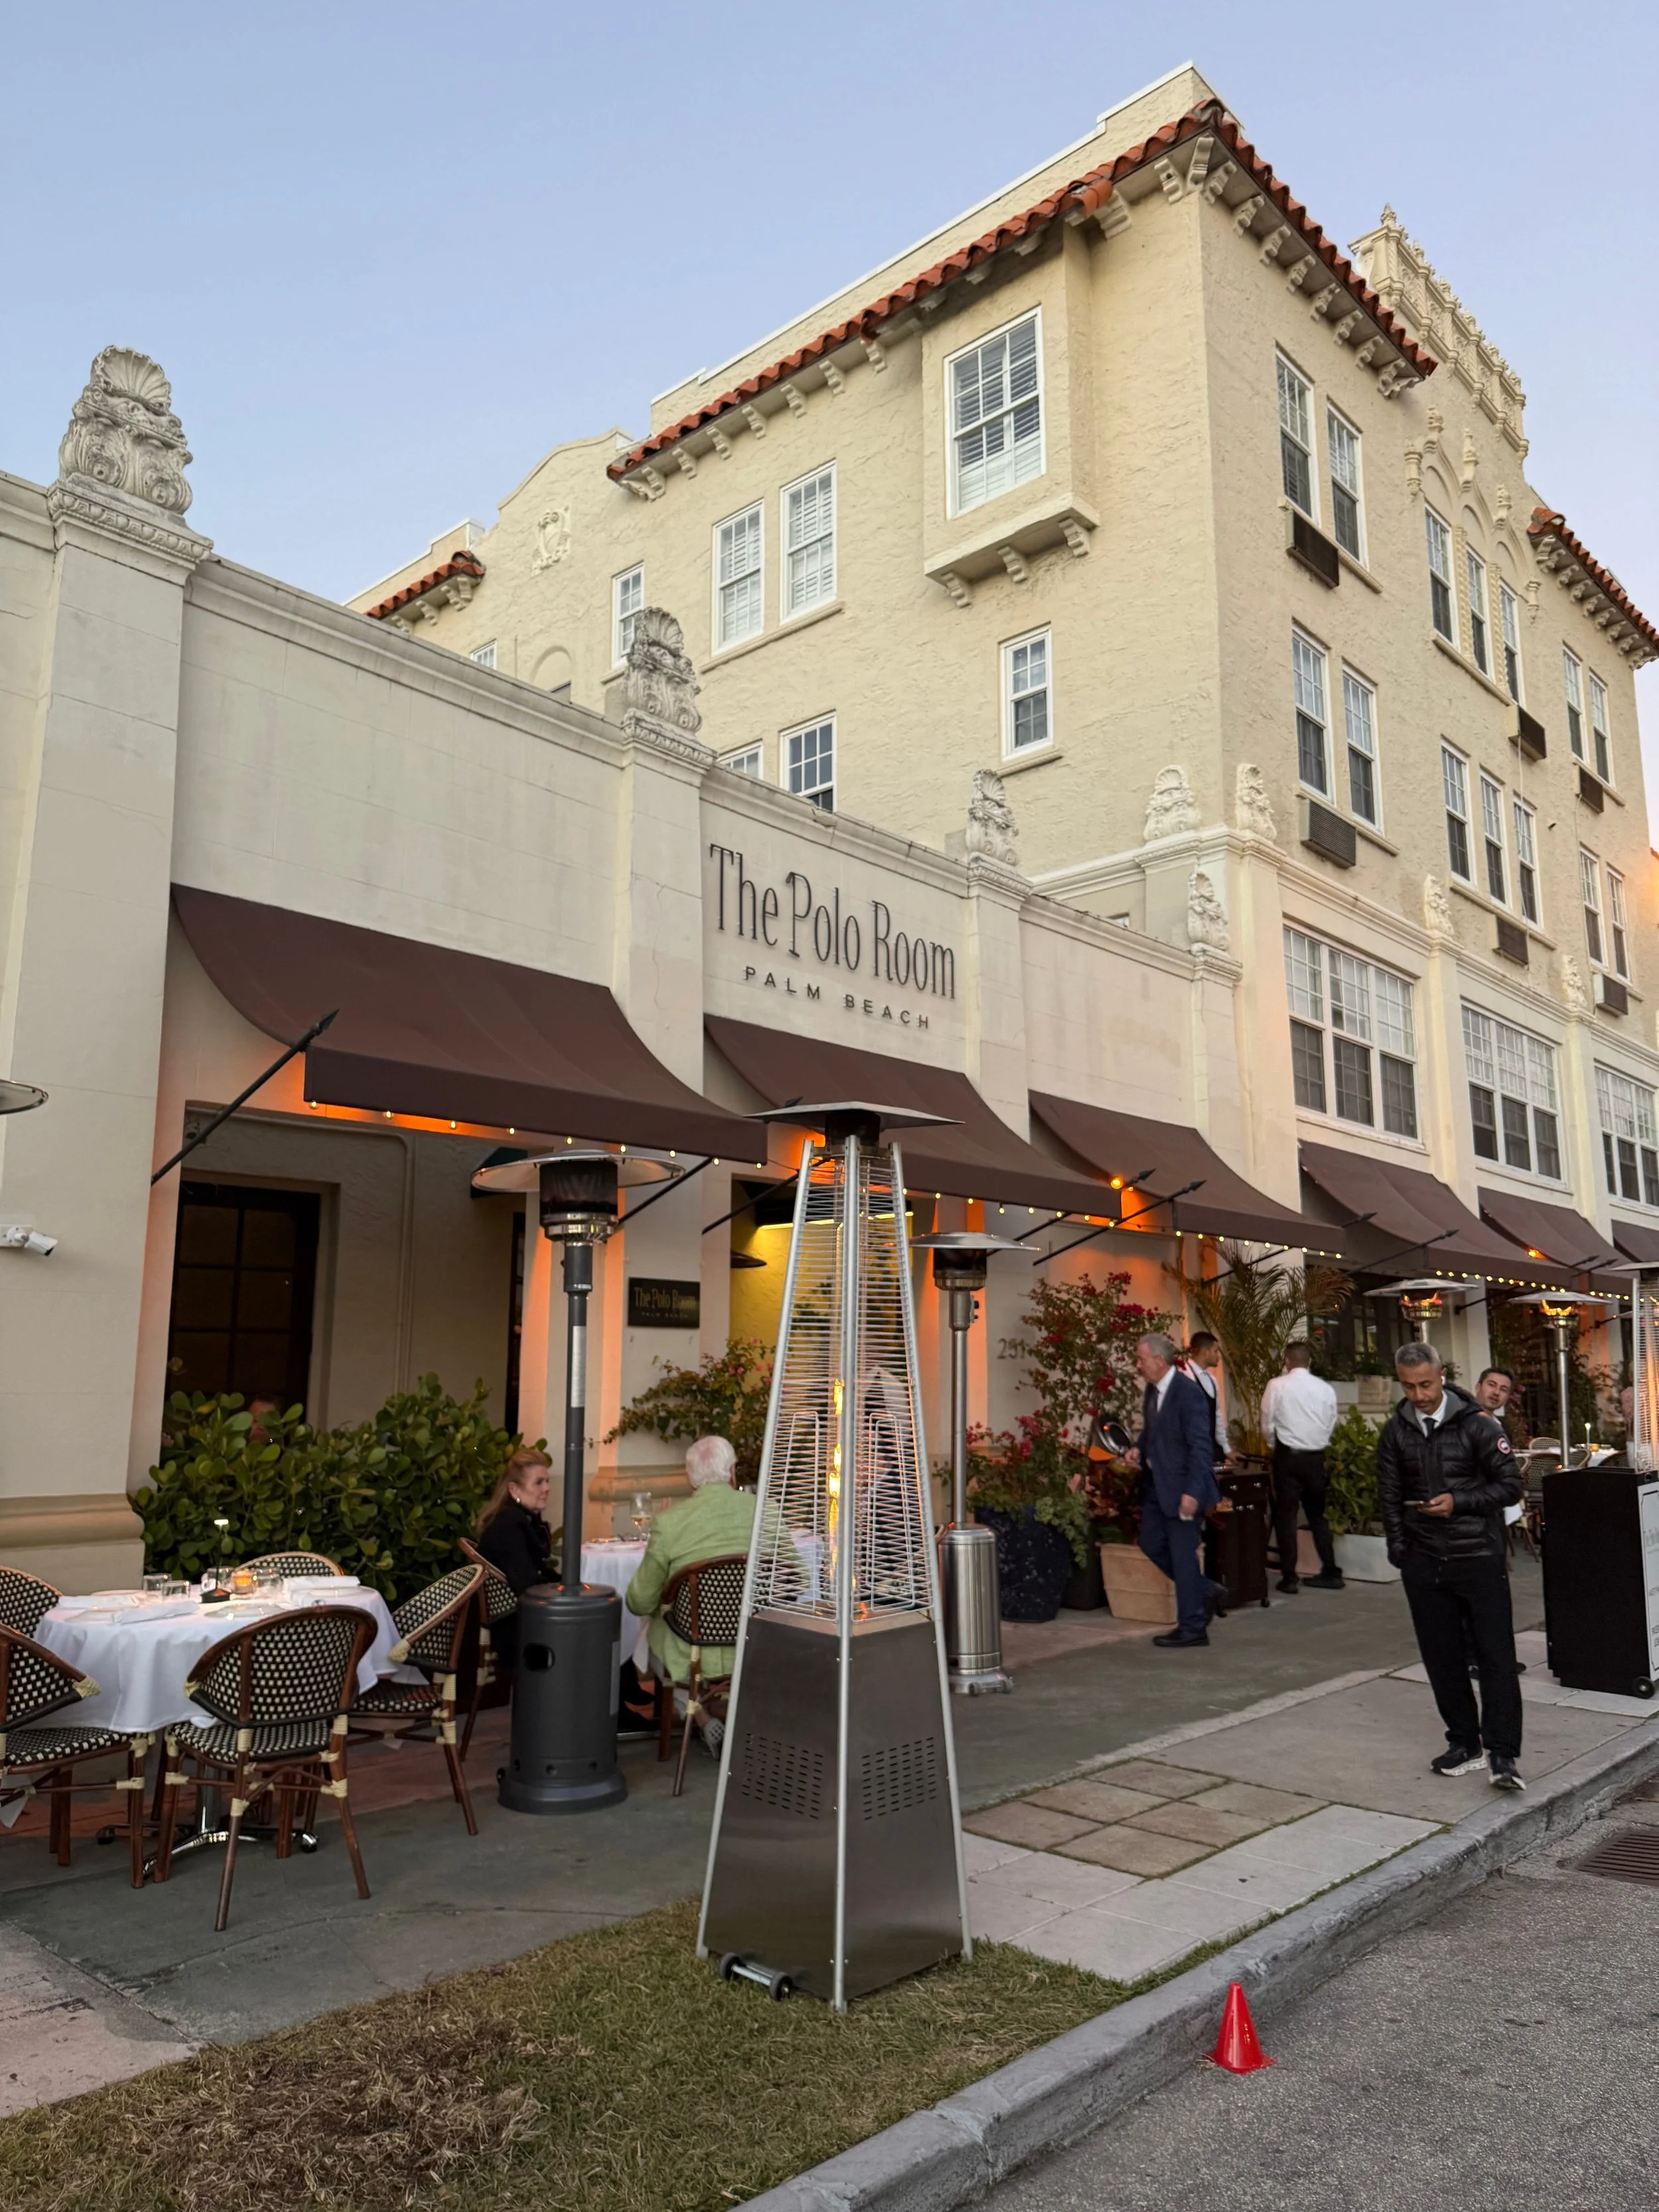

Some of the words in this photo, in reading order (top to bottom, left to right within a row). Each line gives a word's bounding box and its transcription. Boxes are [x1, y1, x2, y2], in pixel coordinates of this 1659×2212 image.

[710, 844, 778, 946] The
[785, 871, 860, 970] Polo
[871, 900, 956, 999] Room
[744, 966, 821, 1000] PALM
[843, 994, 928, 1029] BEACH
